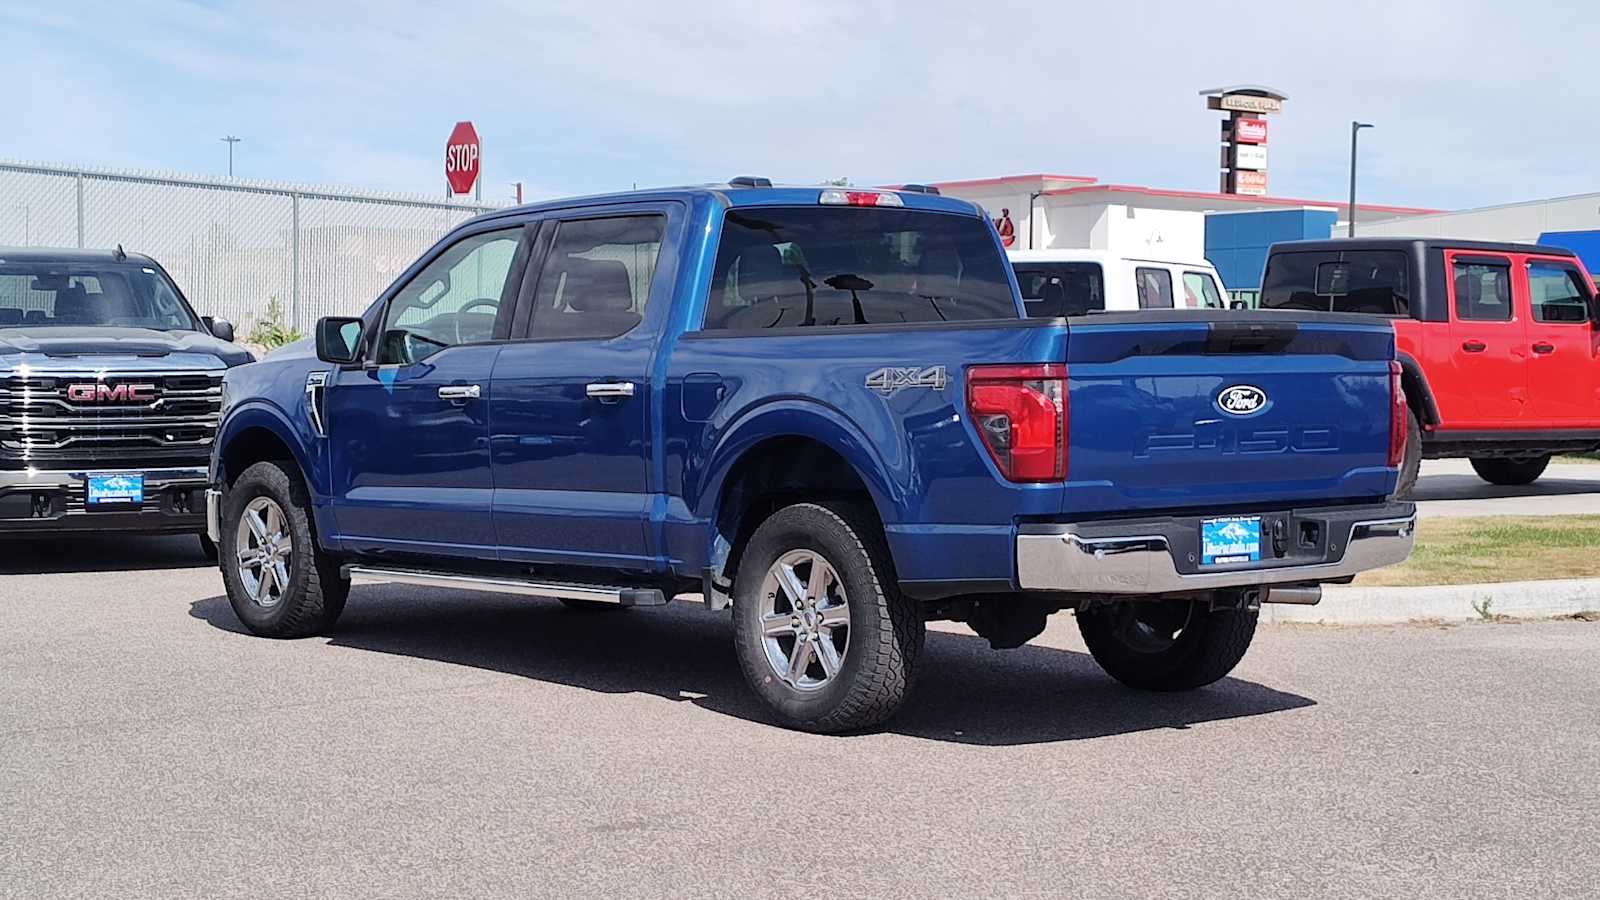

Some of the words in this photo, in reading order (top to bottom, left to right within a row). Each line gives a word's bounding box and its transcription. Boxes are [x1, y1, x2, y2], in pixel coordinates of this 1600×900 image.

[447, 144, 478, 172] STOP
[67, 384, 155, 401] GMC
[1224, 387, 1260, 411] Ford
[1133, 424, 1341, 459] F-150
